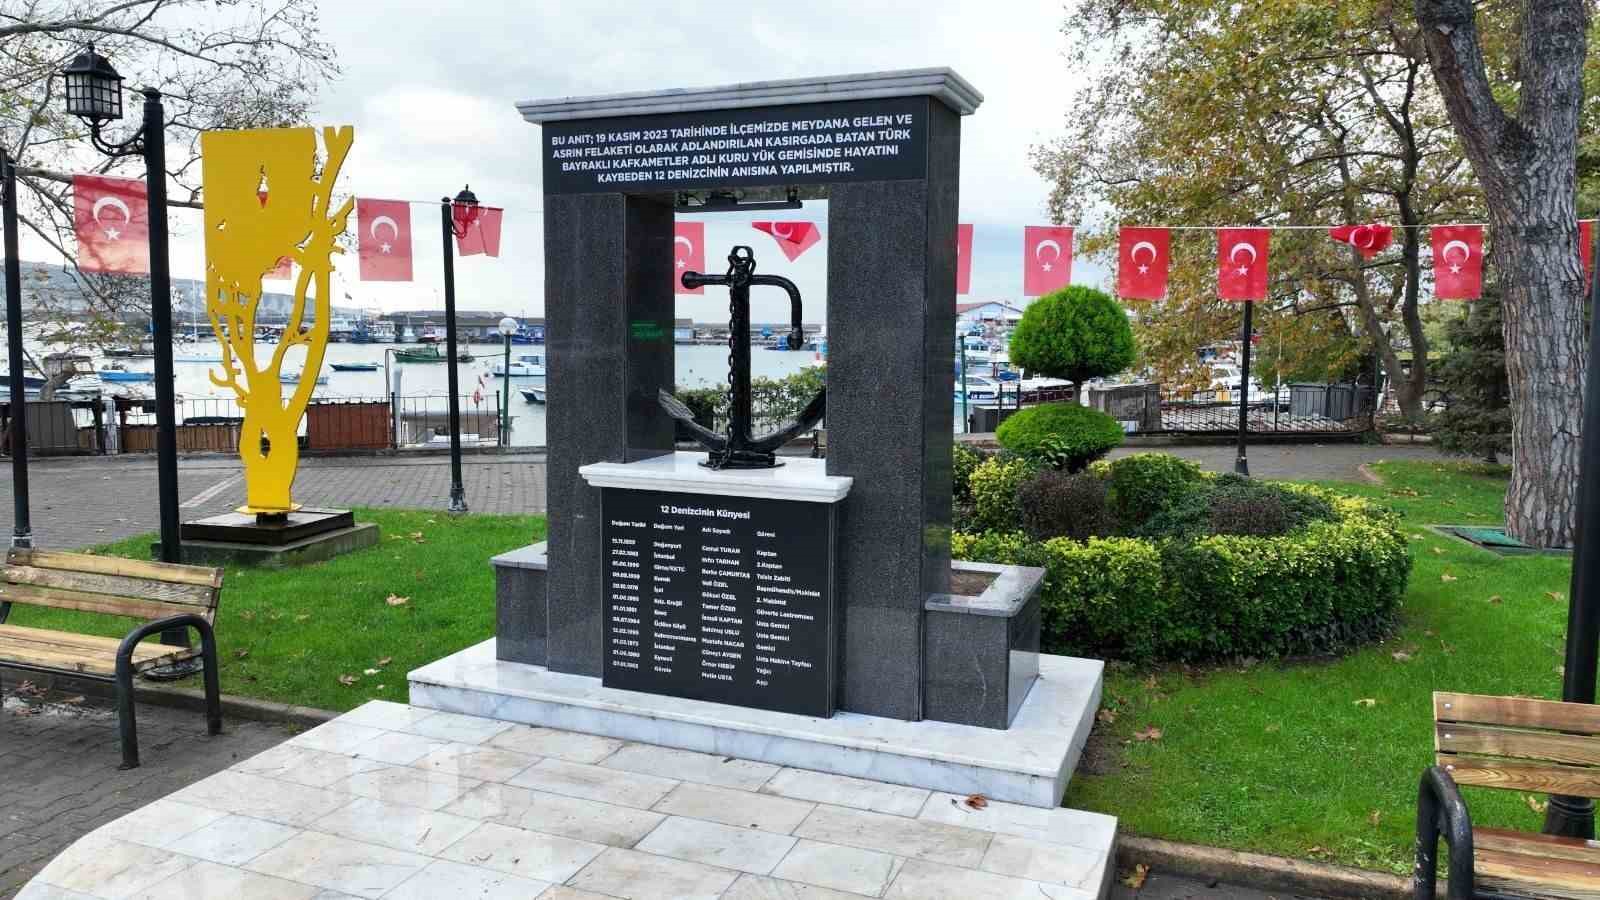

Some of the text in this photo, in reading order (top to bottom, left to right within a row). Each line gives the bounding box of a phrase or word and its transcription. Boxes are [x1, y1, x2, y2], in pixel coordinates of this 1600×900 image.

[552, 114, 912, 145] BU ANIT; 19 KASIM 2023 TARİHİNDE İLÇEMİZDE MEYDANA GELEN VE
[553, 128, 910, 158] ASRIN FELAKETİ OLARAK ADLANDIRILAN KASIRGADA BATAN TÜRK
[562, 145, 898, 171] BAYRAKLI KAFKAMETLER ADLI KURU YÜK GEMİSİNDE HAYATINI
[597, 162, 854, 183] KAYBEDEN 12 DENİZCİNİN ANISINA YAPILMIŞTIR.
[661, 505, 750, 519] 12 Denizcinin Künyesi
